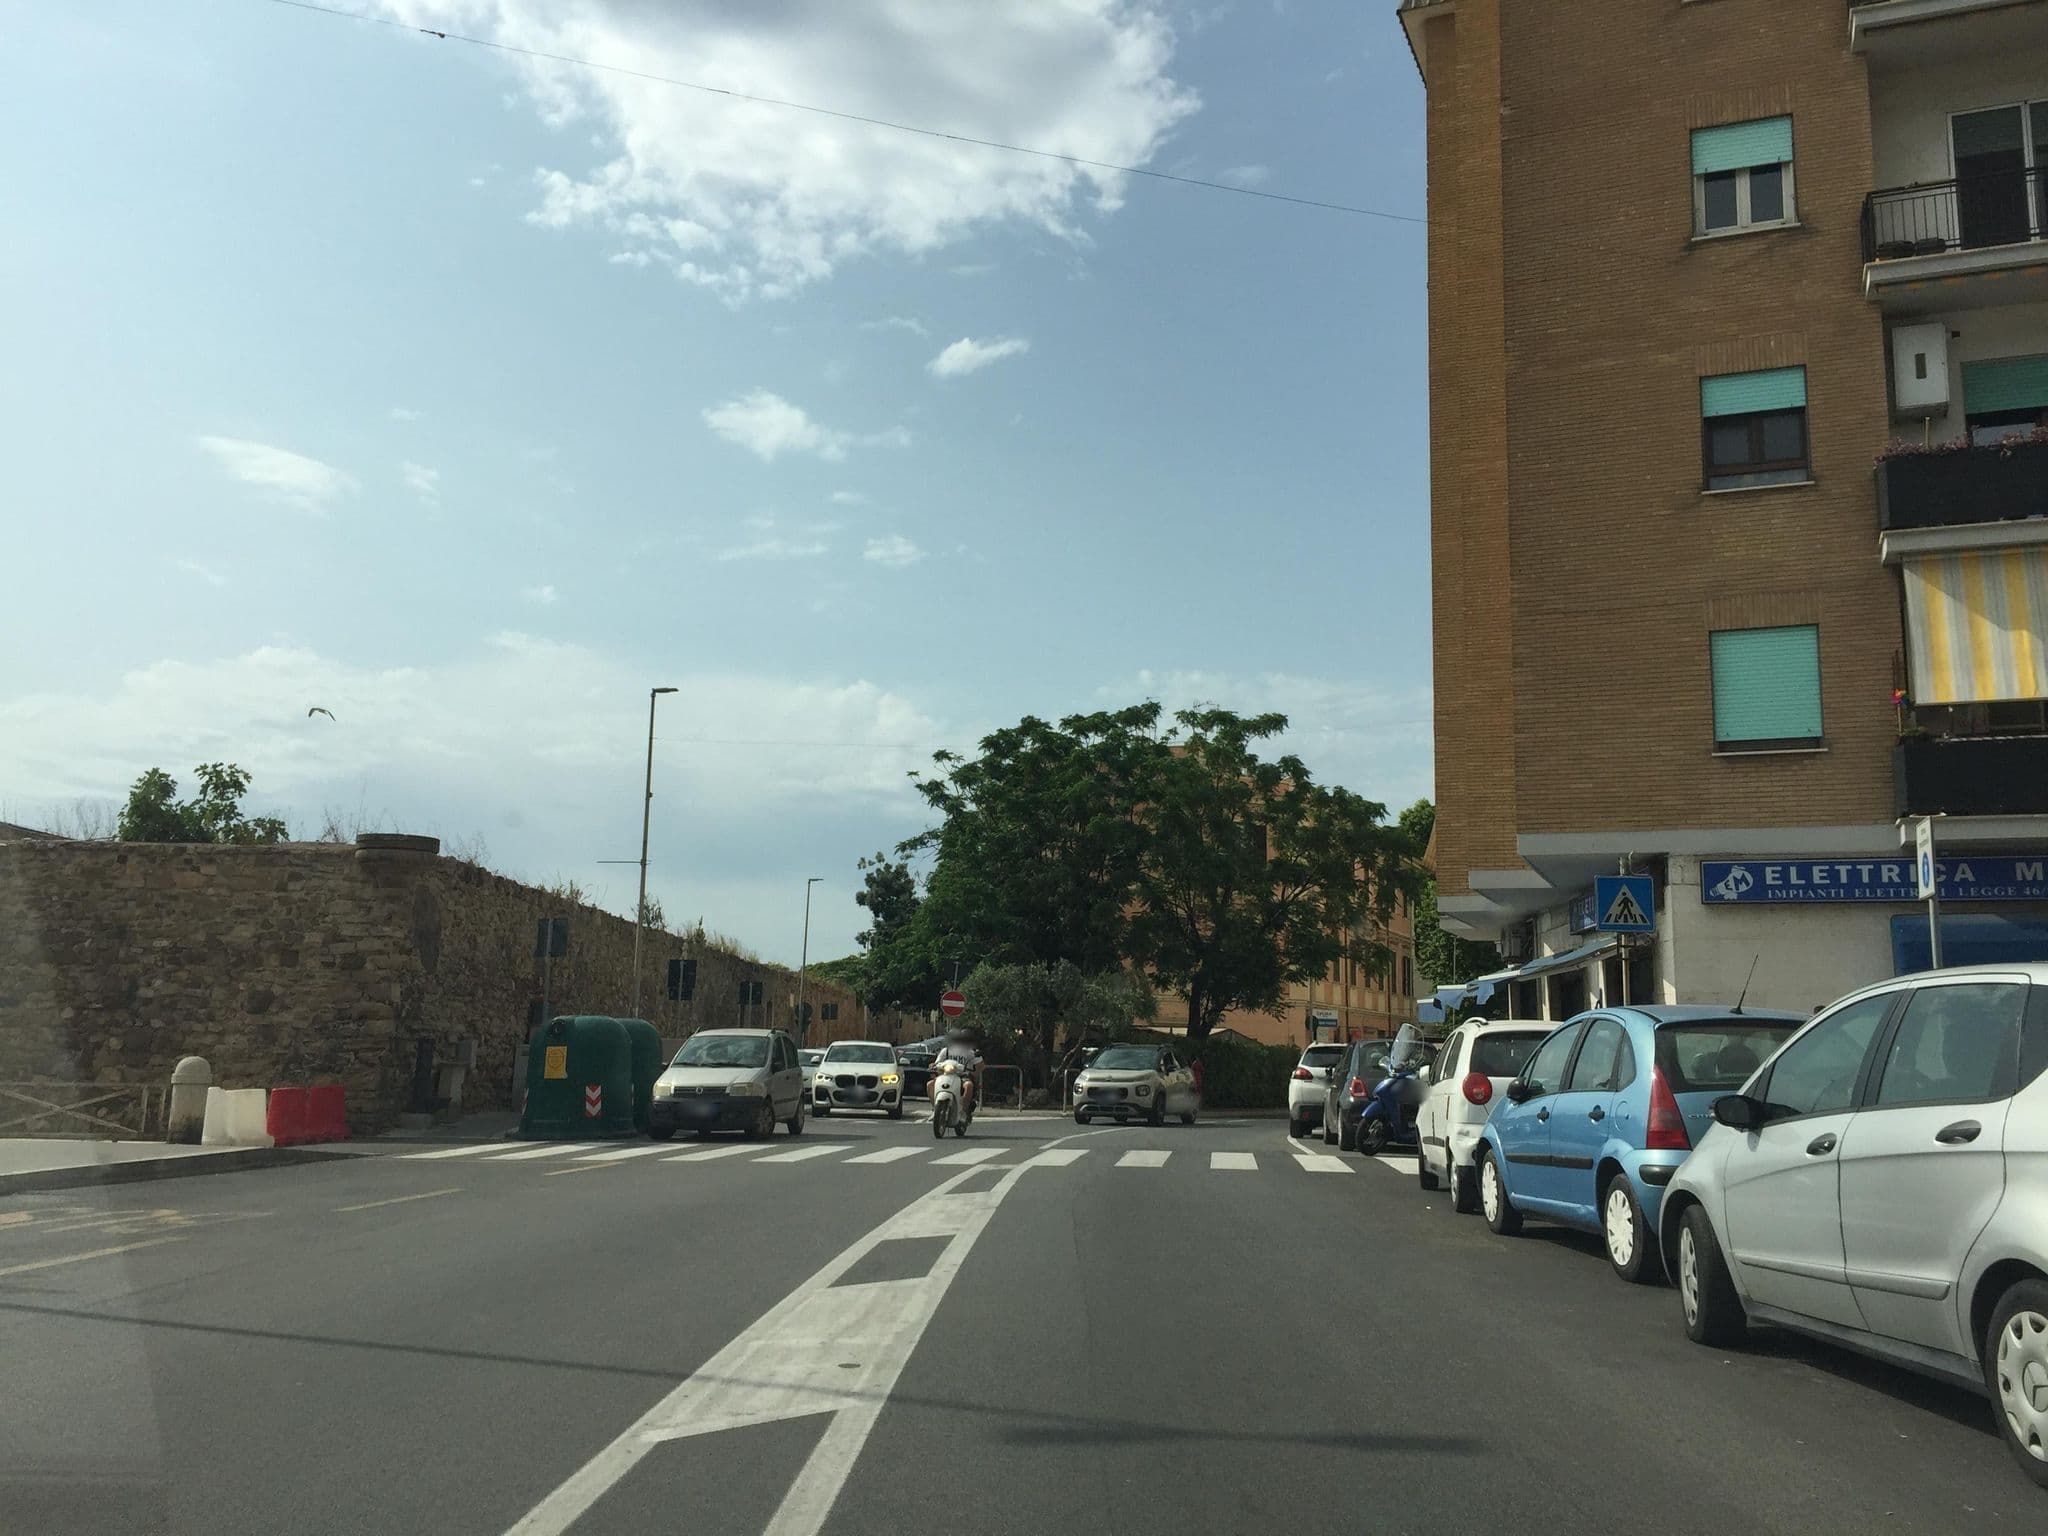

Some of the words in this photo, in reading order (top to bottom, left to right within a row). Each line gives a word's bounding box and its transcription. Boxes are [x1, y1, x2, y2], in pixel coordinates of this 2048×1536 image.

[1767, 888, 1845, 899] IMPIANTI
[1855, 886, 1946, 898] ELETTRI
[1959, 886, 2017, 897] LEGGE
